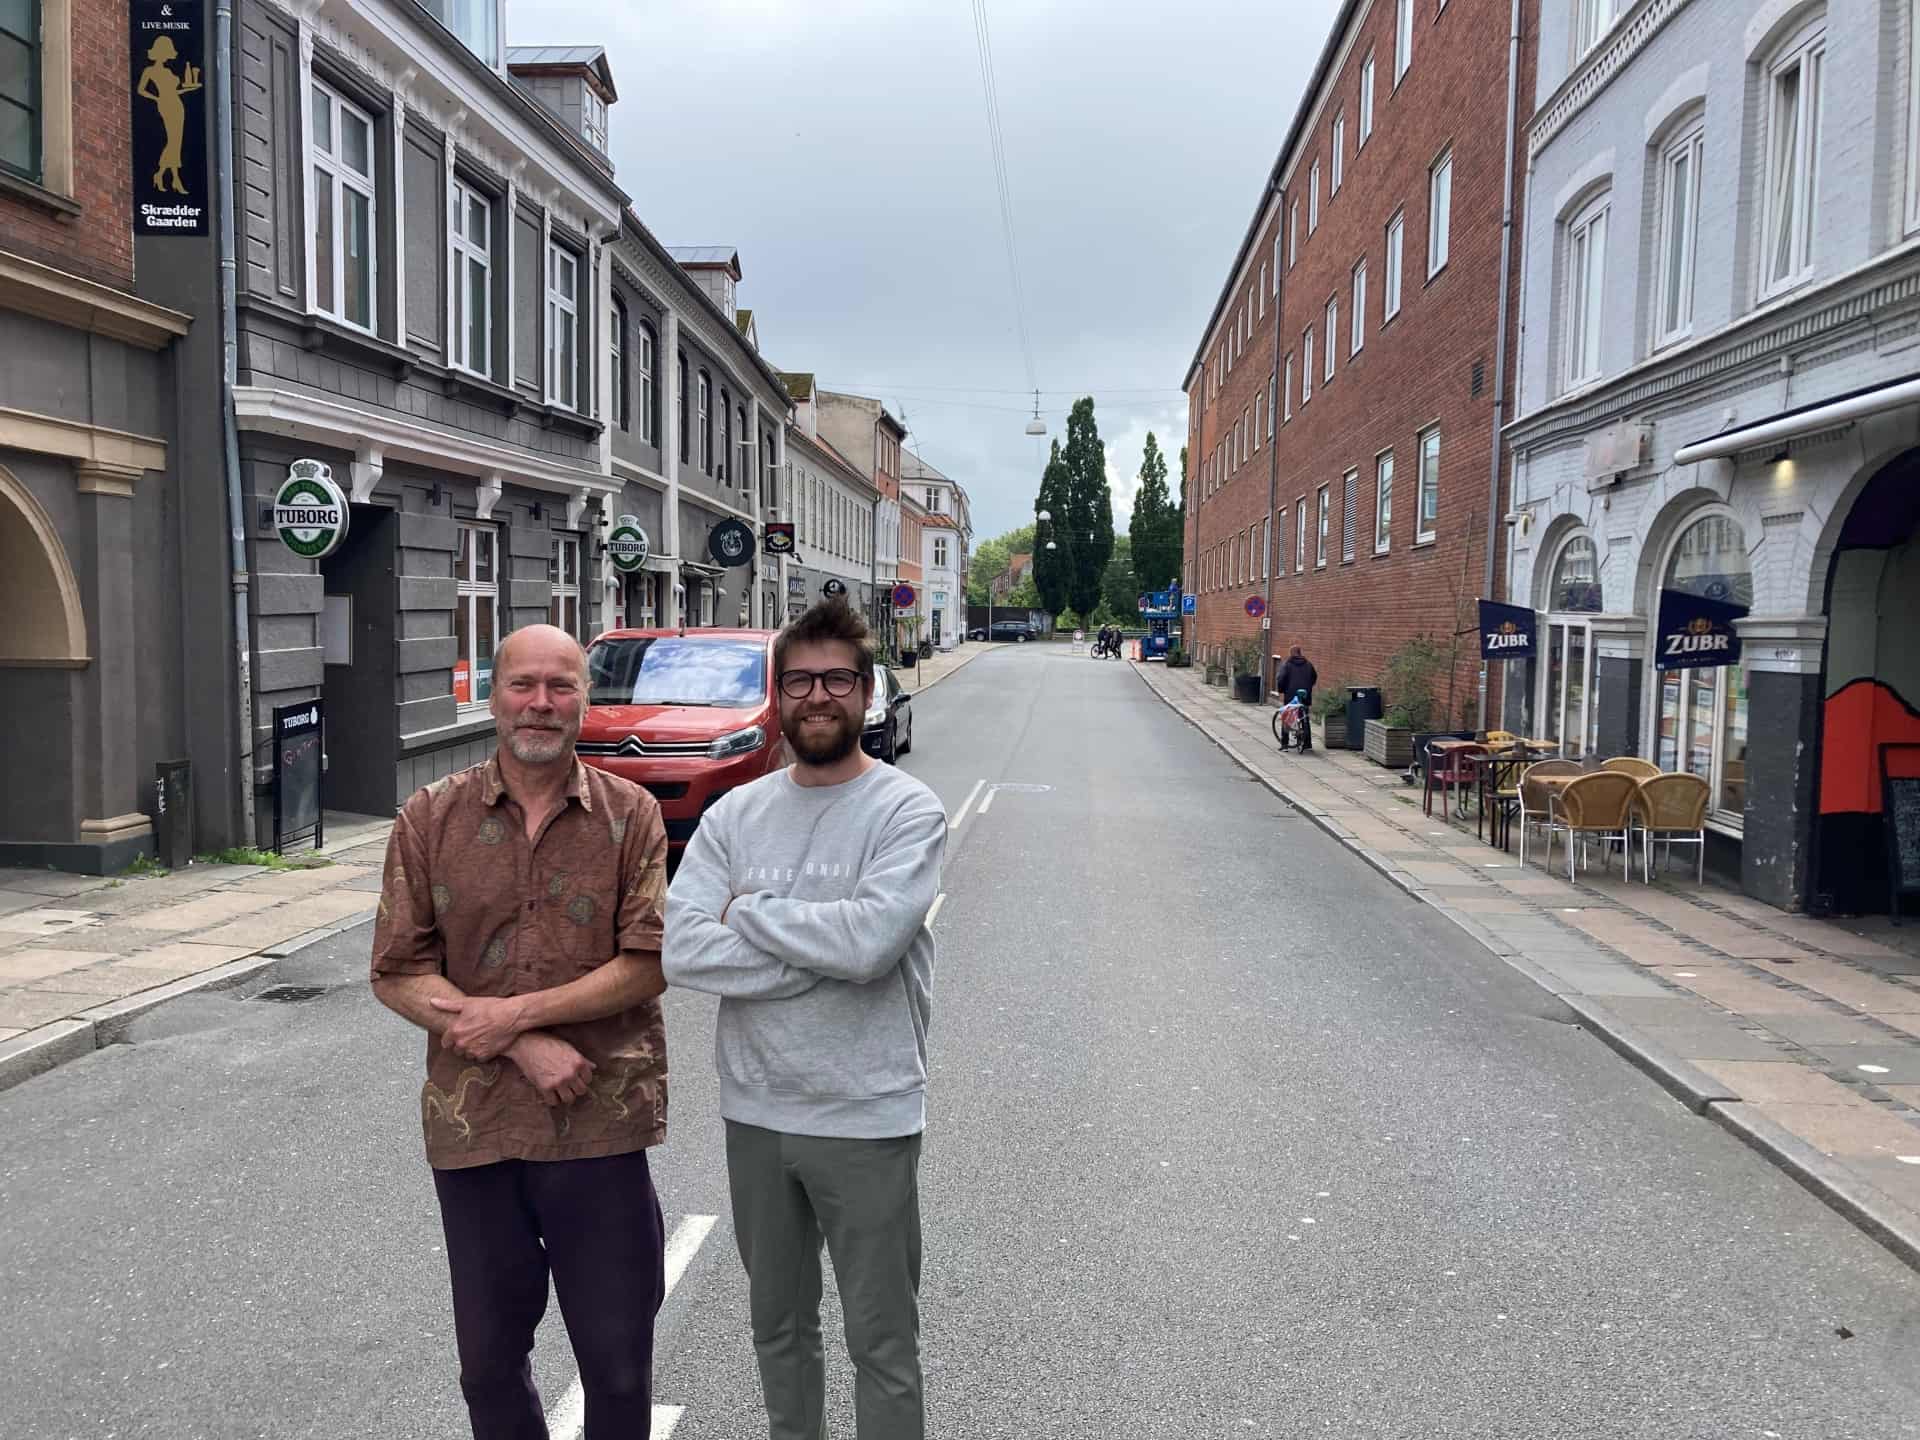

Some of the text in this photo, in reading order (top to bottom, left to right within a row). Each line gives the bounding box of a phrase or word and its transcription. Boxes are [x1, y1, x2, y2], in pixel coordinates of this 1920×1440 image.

[161, 4, 172, 16] &
[142, 21, 190, 30] LIVE MUSIK
[141, 204, 201, 216] Skrædder
[146, 215, 197, 228] Gaarden
[276, 509, 338, 524] TUBORG
[609, 543, 646, 553] TUBORG
[1486, 633, 1529, 650] ZUBR
[1664, 633, 1729, 656] ZUBR
[283, 712, 310, 729] TUBORG
